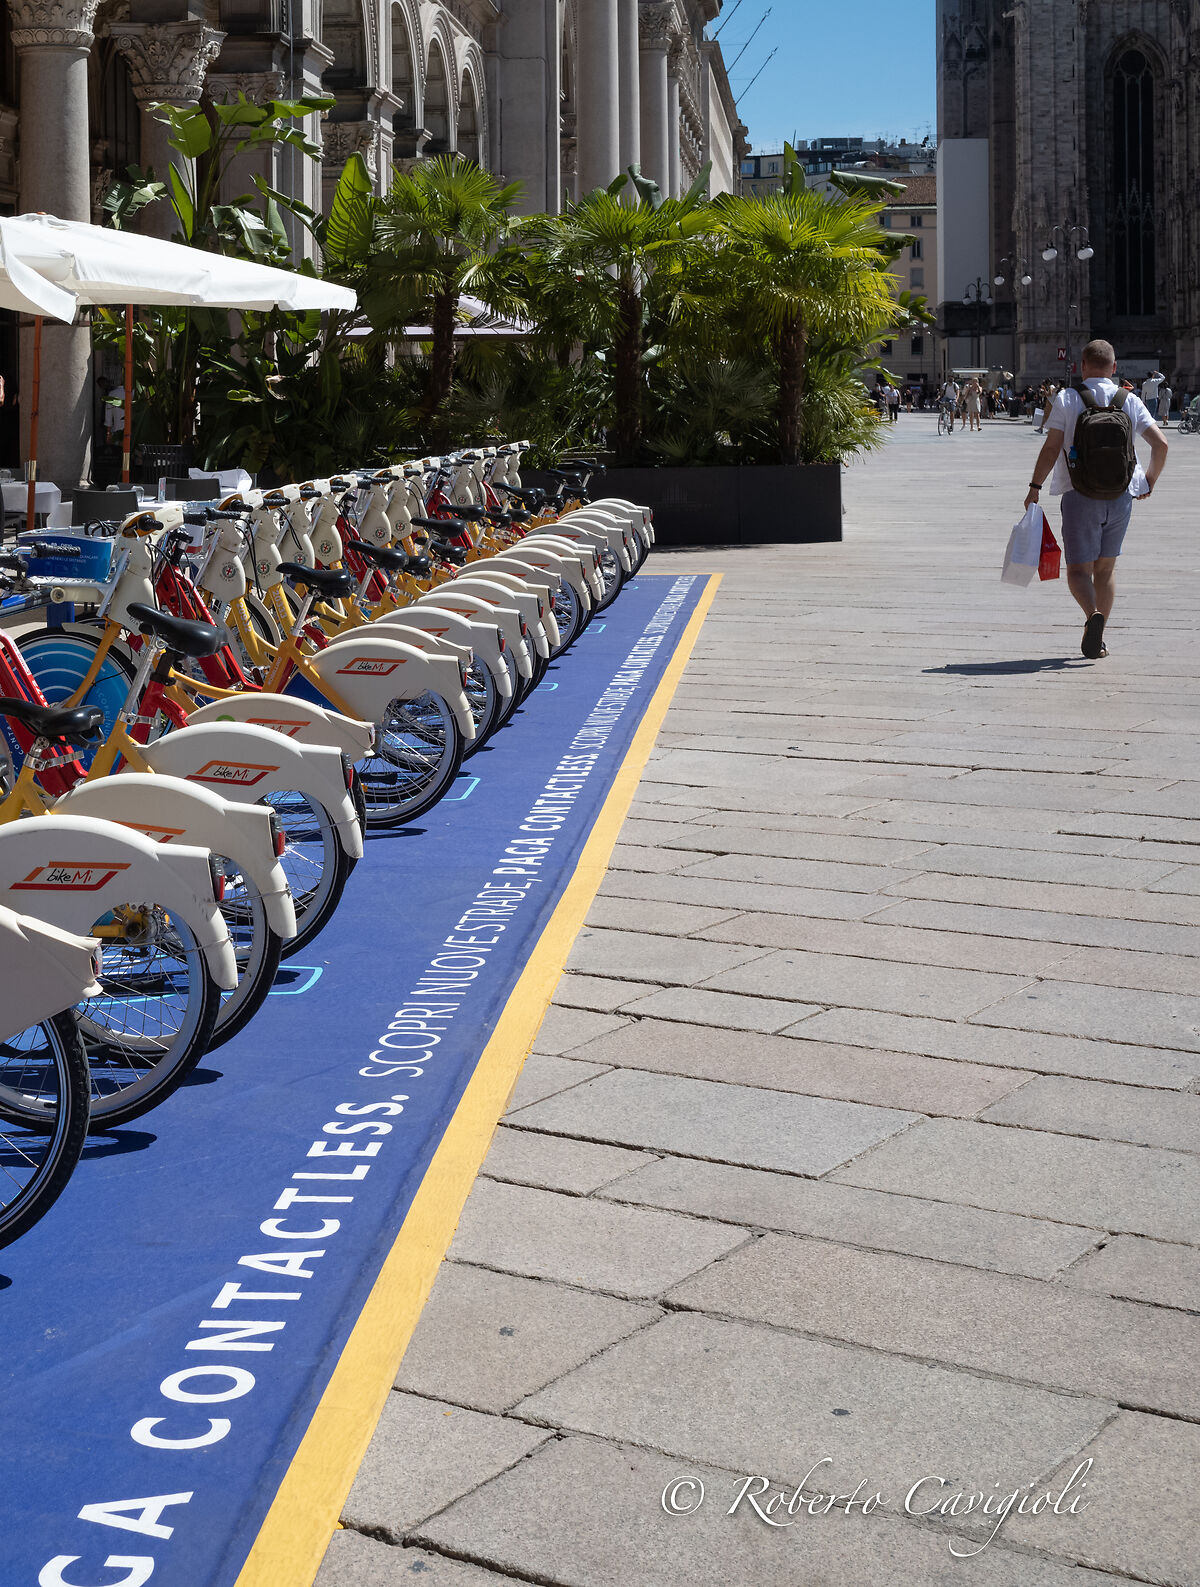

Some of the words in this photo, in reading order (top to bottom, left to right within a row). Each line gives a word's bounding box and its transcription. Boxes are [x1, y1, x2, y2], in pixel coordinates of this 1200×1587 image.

[213, 767, 250, 780] bikeMi
[519, 753, 600, 831] CONTACTLESS.
[47, 869, 93, 884] bikeMi
[492, 837, 555, 874] PAGA
[454, 878, 543, 932] STRADE,
[410, 935, 500, 995] NUOVE
[358, 1002, 460, 1078] SCOPRI
[130, 1094, 409, 1449] CONTACTLESS.
